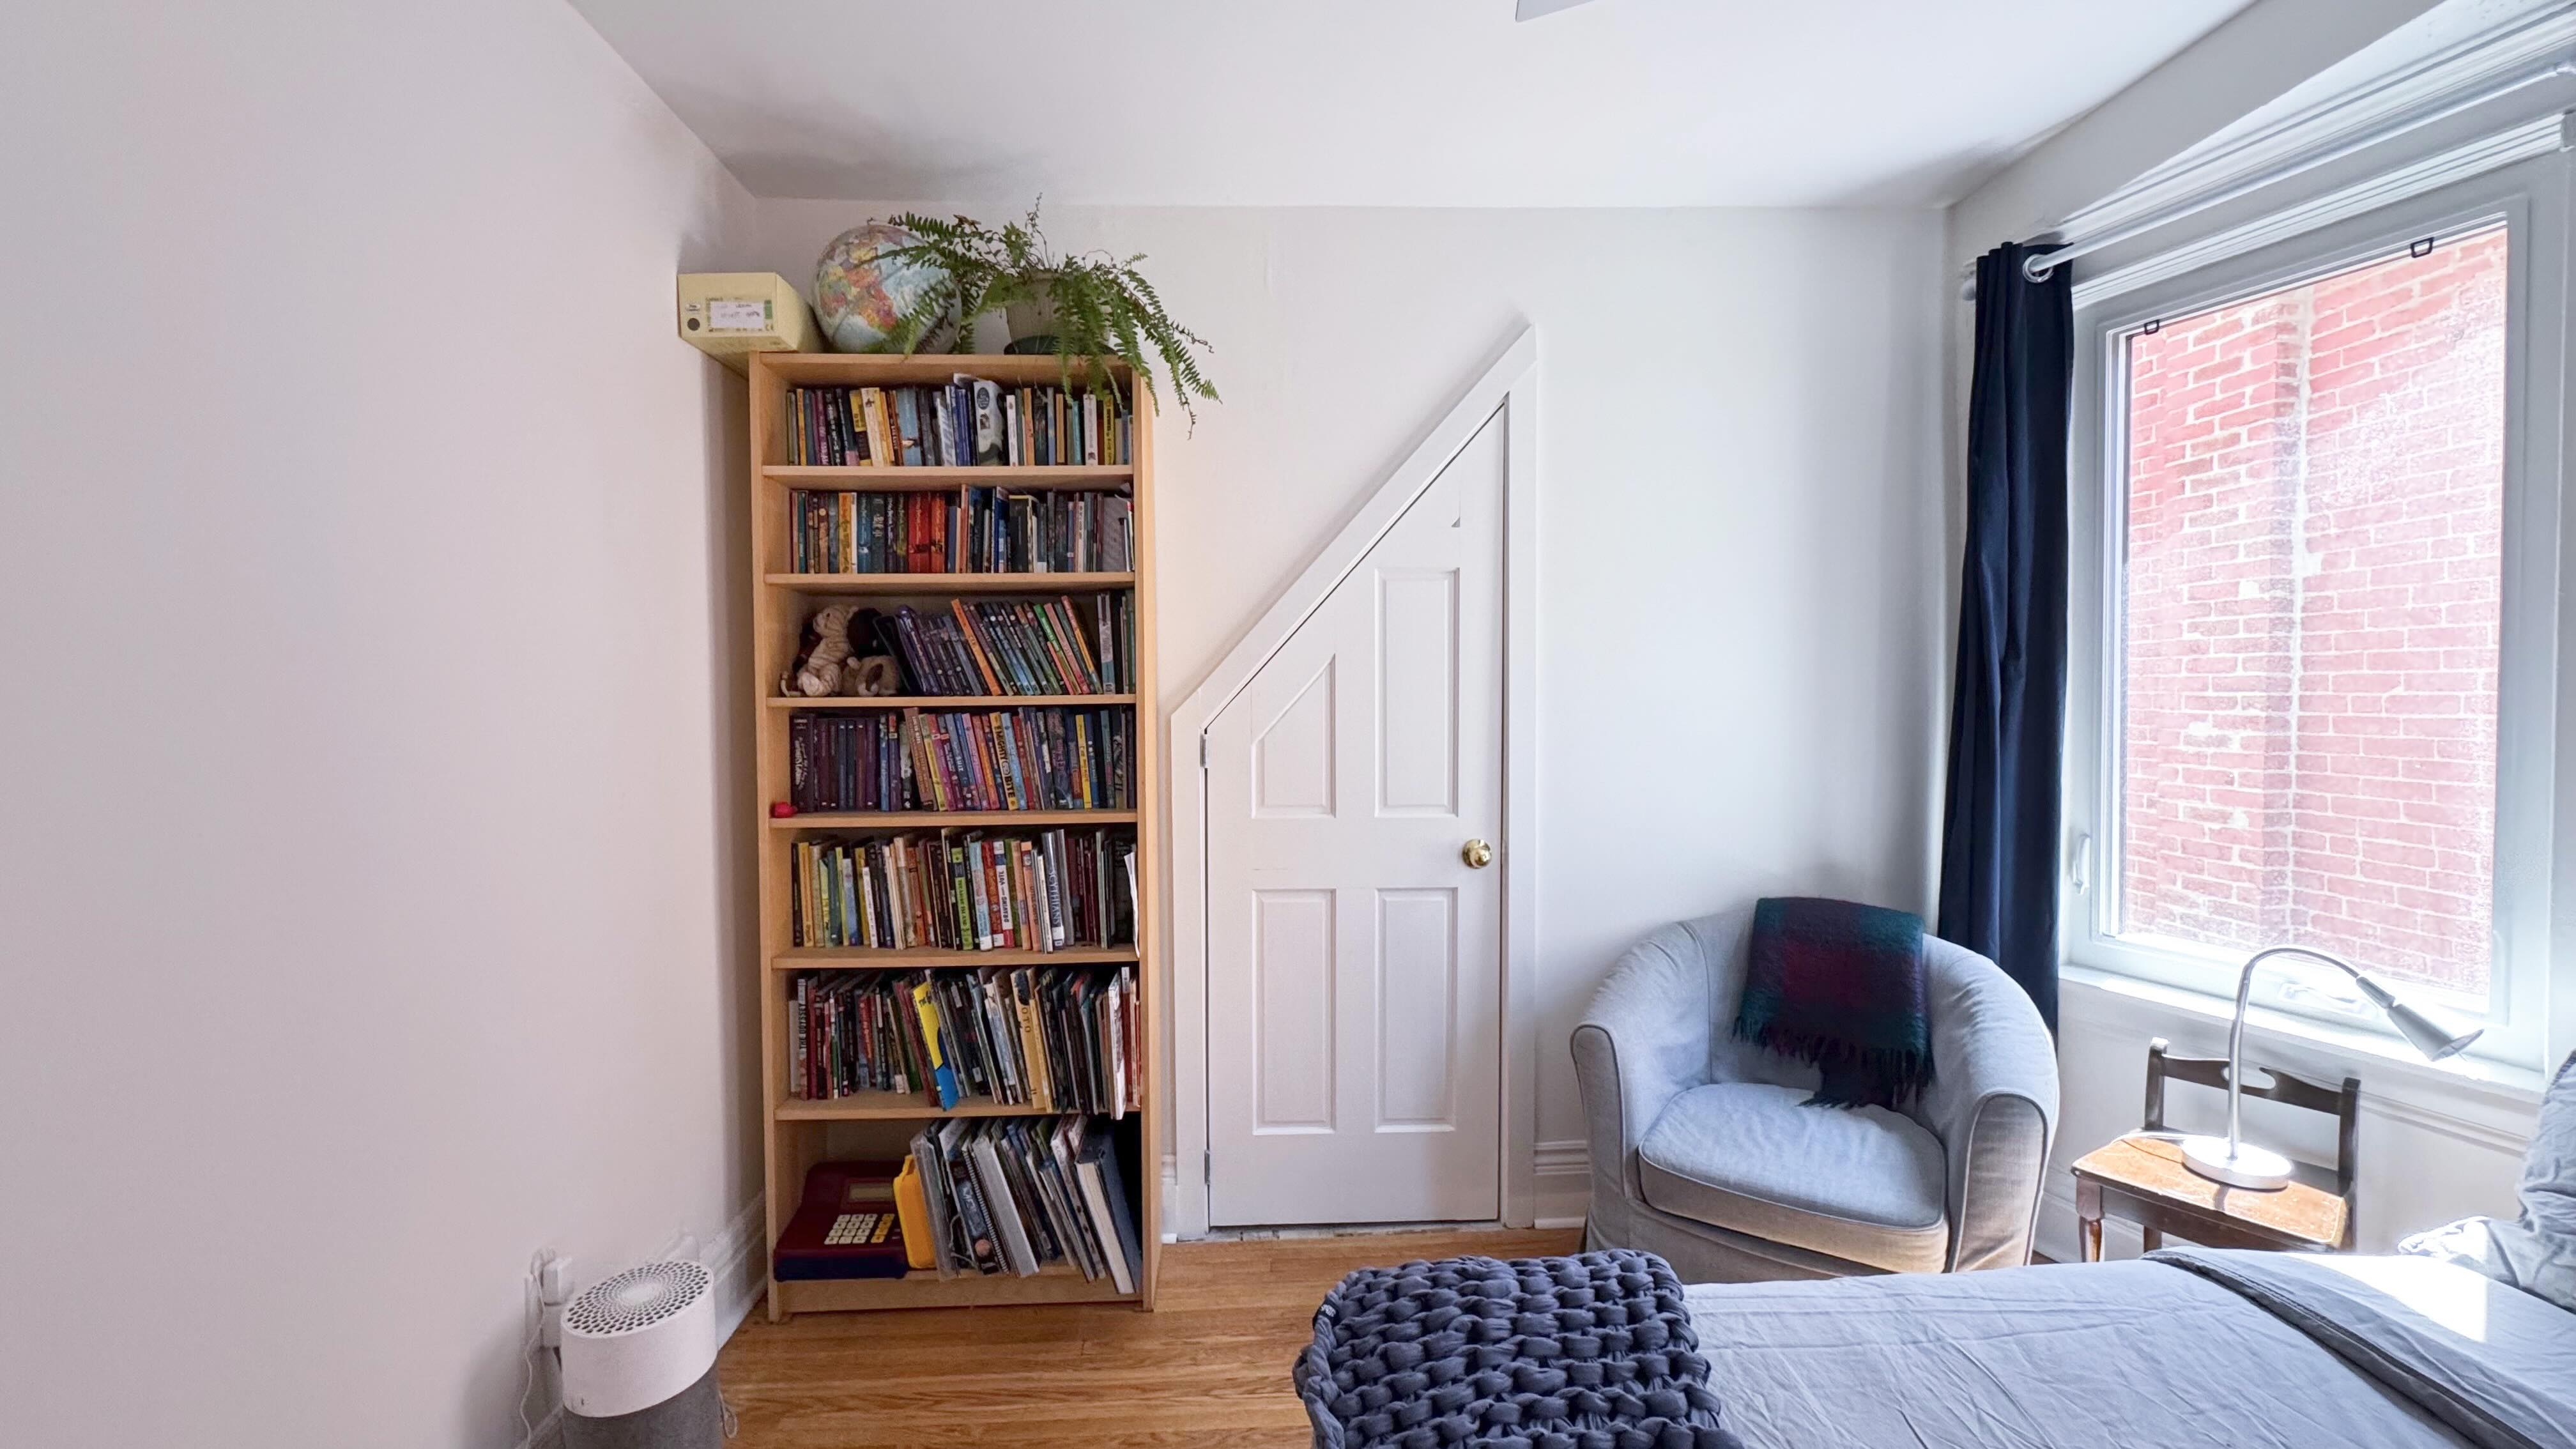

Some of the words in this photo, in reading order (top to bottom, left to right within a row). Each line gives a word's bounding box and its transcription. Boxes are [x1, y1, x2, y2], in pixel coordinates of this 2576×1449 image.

[996, 730, 1009, 760] MIGHTY
[1005, 777, 1016, 799] BITE
[1047, 867, 1061, 925] SCYTHIANS
